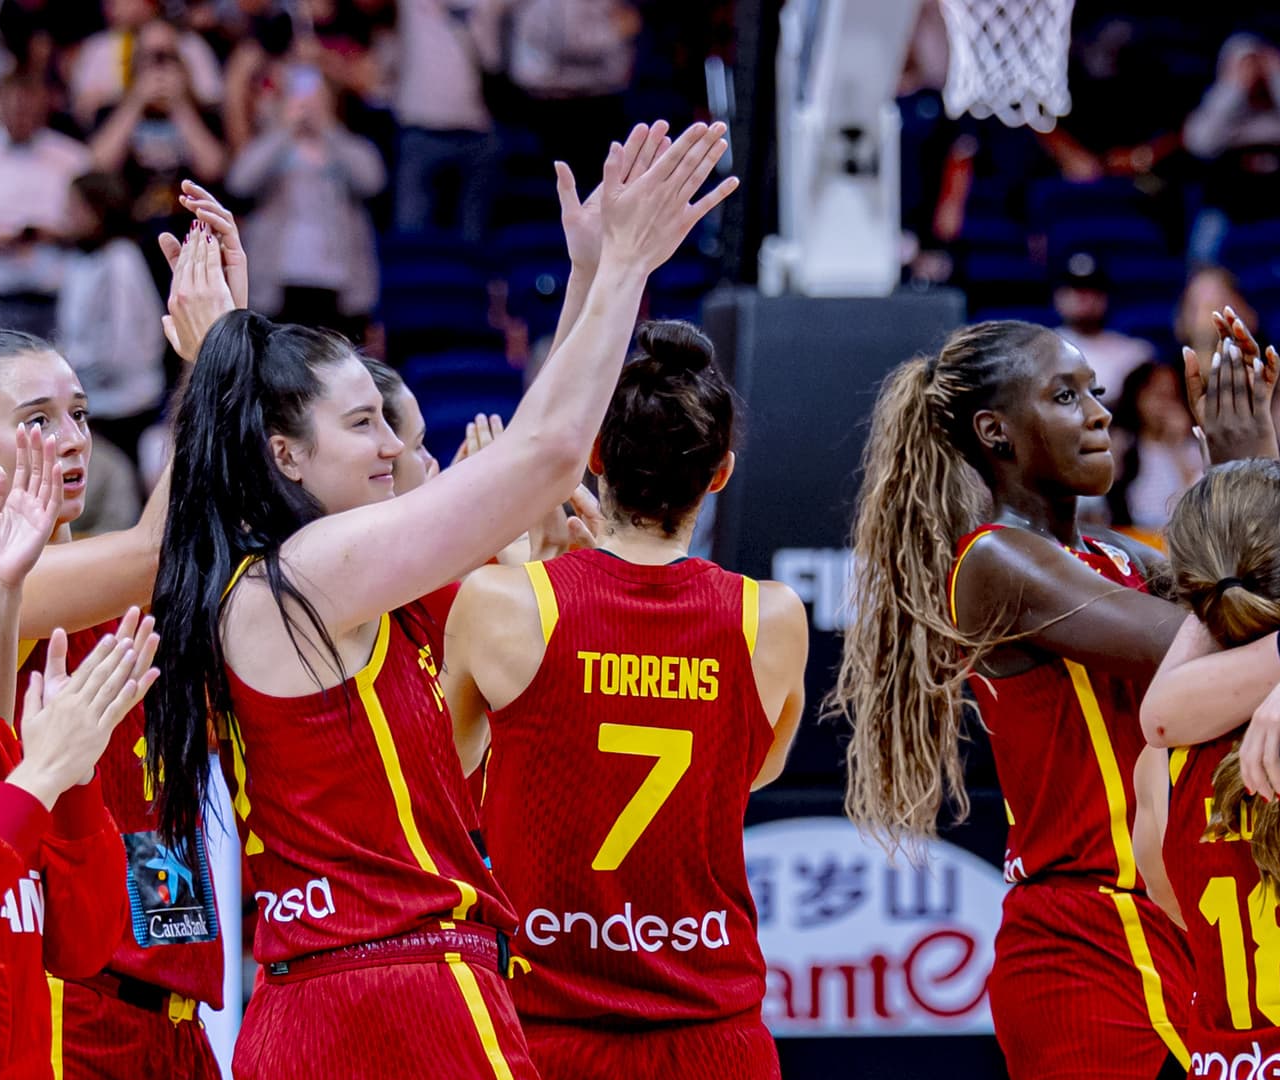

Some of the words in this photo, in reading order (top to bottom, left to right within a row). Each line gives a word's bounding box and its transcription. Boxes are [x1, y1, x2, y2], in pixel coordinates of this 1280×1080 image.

[577, 651, 720, 701] TORRENS
[591, 723, 693, 871] 7
[150, 914, 208, 939] CaixaBank
[525, 902, 730, 952] endesa
